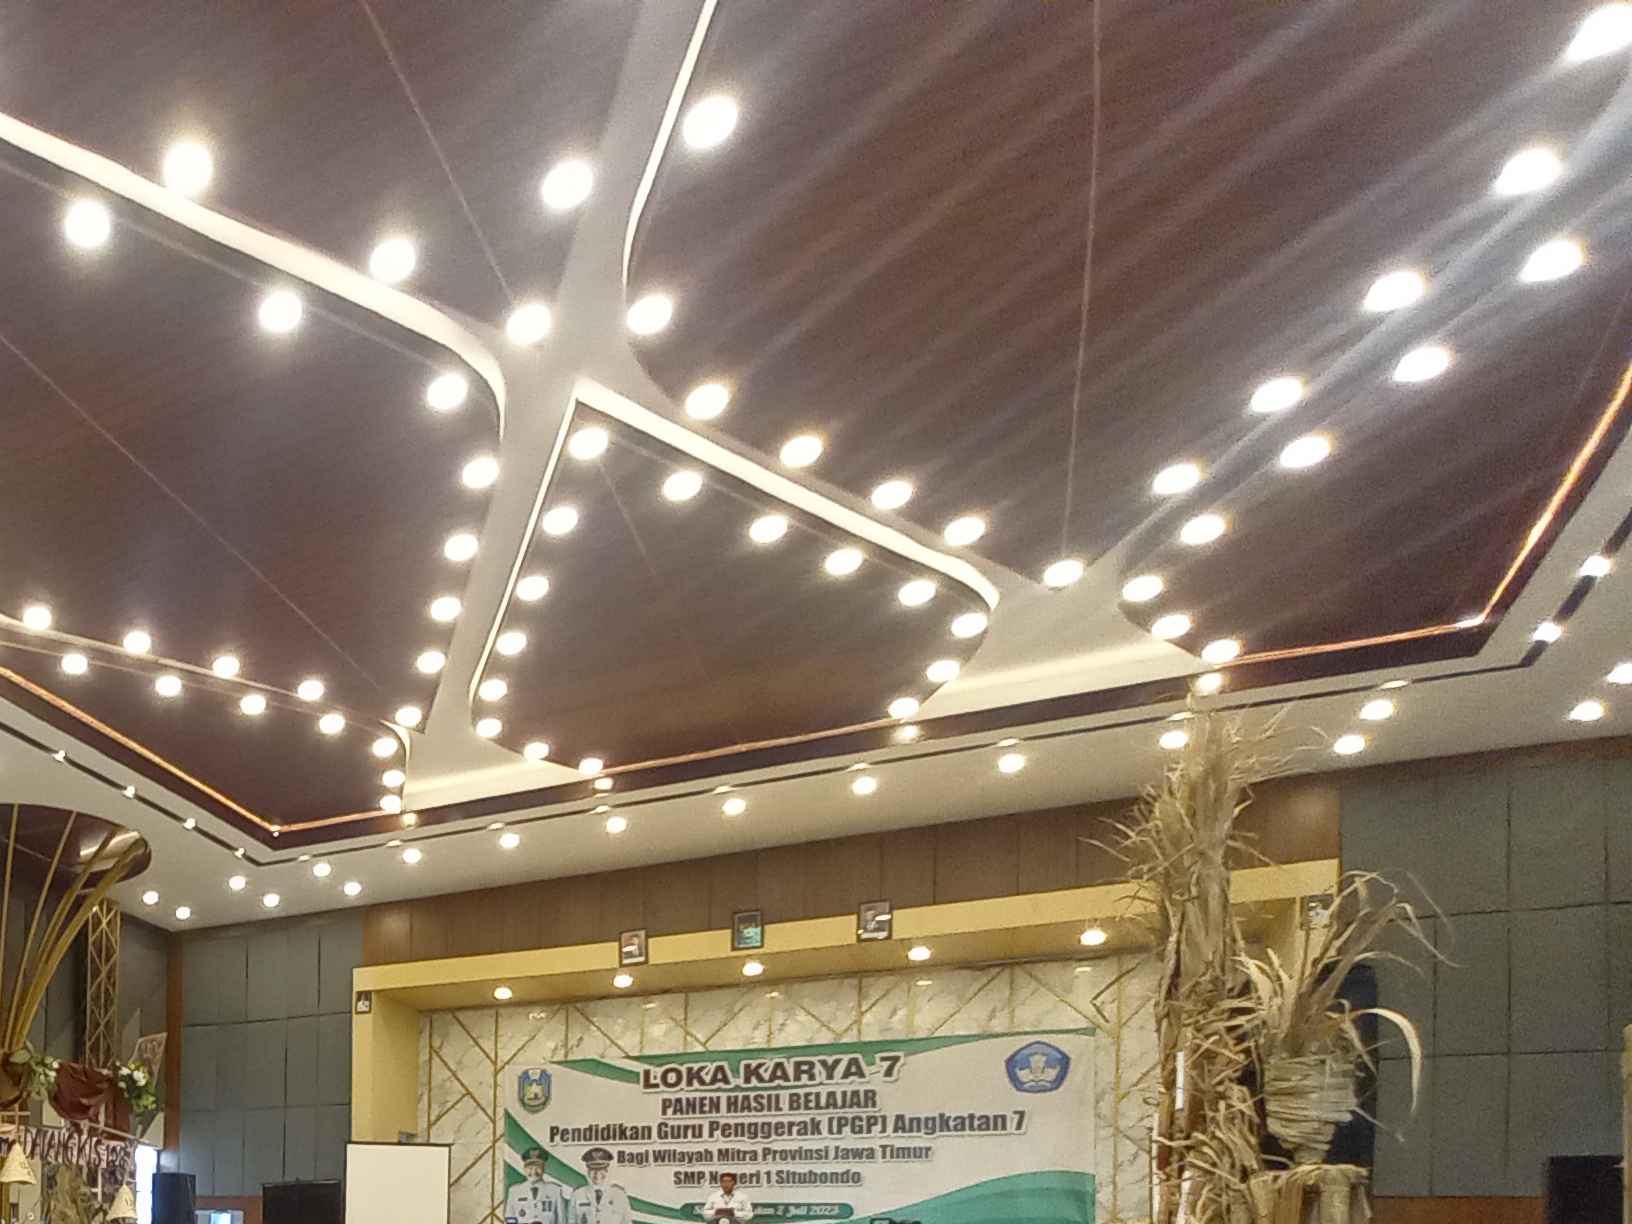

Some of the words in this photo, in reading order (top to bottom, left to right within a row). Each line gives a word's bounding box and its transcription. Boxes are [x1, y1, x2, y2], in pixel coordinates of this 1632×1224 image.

[643, 1064, 730, 1089] LOKA
[743, 1057, 866, 1084] KARYA
[879, 1055, 901, 1078] 7
[661, 1095, 720, 1116] PANEN
[726, 1093, 783, 1114] HASIL
[788, 1089, 878, 1112] BELAJAR
[549, 1122, 652, 1143] Pendidikan
[657, 1120, 703, 1140] Guru
[709, 1116, 822, 1140] Penggerak
[892, 1111, 1008, 1136] Angkatan
[1012, 1110, 1026, 1131] 7
[617, 1150, 649, 1165] Bagi
[653, 1148, 714, 1164] Wilayah
[717, 1147, 758, 1162] Mitra
[762, 1146, 829, 1162] Provinsi
[833, 1145, 876, 1161] Jawa
[879, 1144, 932, 1160] Timur
[673, 1171, 706, 1185] SMP
[776, 1169, 862, 1185] Situbondo
